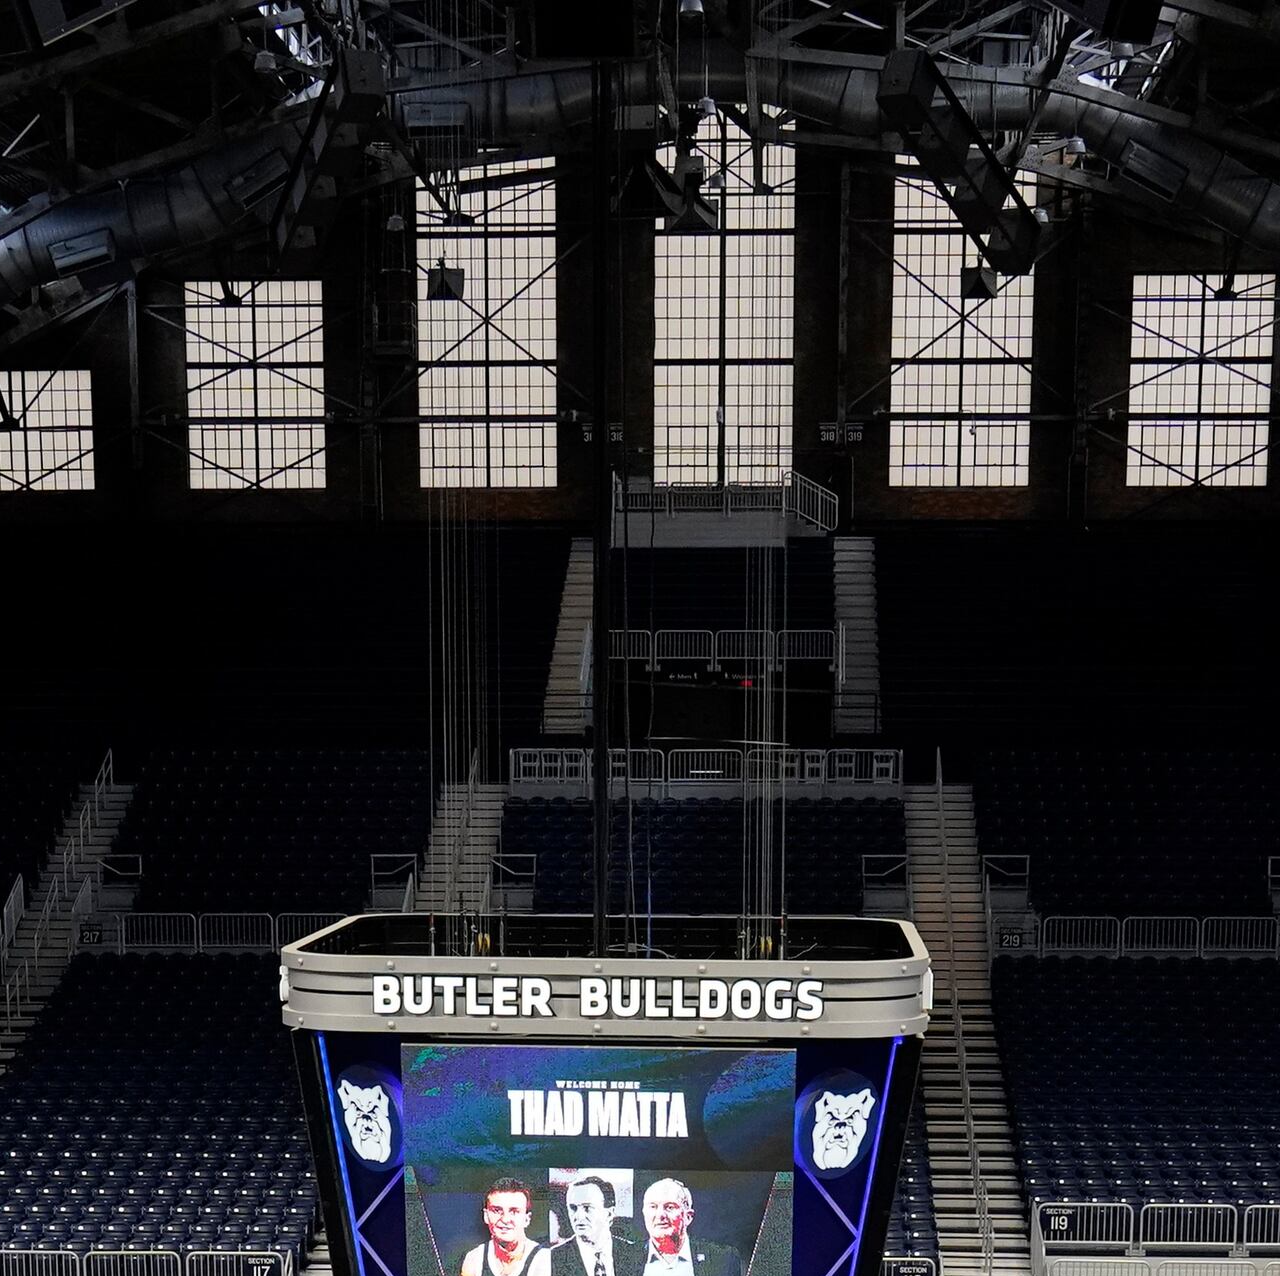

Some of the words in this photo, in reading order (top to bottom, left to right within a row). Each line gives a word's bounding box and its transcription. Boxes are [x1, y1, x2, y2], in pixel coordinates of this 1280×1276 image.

[83, 931, 100, 943] 217
[1002, 934, 1020, 946] 219
[372, 975, 554, 1018] BUTLER
[580, 977, 824, 1021] BULLDOGS
[556, 1080, 608, 1090] WELCOME
[610, 1080, 640, 1090] HOME
[509, 1089, 584, 1137] THAD
[587, 1091, 688, 1138] MATTA
[1049, 1215, 1068, 1230] 119
